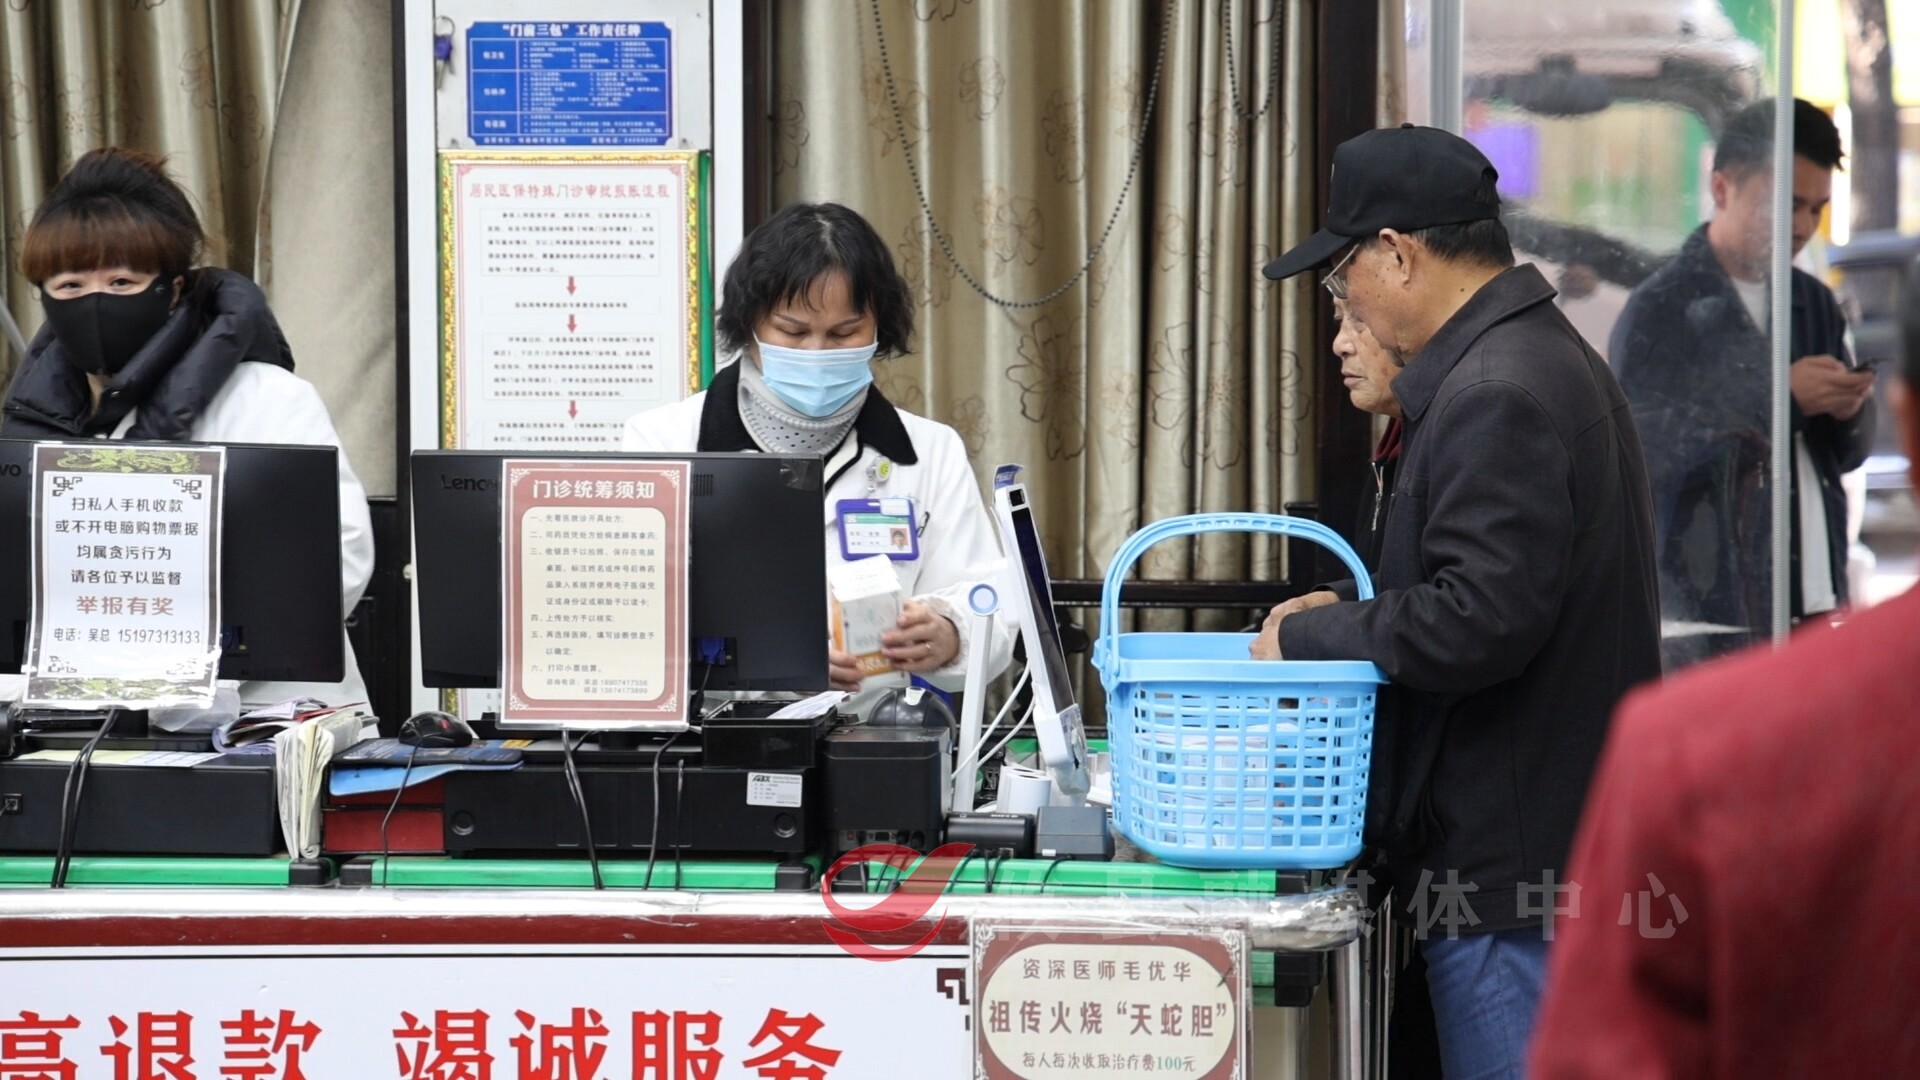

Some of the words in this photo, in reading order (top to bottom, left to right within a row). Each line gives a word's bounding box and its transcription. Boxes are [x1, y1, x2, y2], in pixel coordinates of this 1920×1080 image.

[533, 479, 655, 499] 门诊统筹须知
[72, 498, 184, 513] 扫私人手机收款
[55, 520, 199, 536] 或不开电脑购物票据
[77, 545, 171, 561] 均属贪污行为
[71, 570, 182, 586] 请各位予以监督
[76, 596, 174, 616] 举报有奖
[118, 629, 200, 644] 15197313133
[1022, 958, 1192, 982] 资深医师毛优华
[989, 1000, 1227, 1037] 祖传火烧“天蛇胆”
[392, 1007, 843, 1080] 竭诚服务
[1022, 1052, 1197, 1072] 每人每次收取治疗费100元
